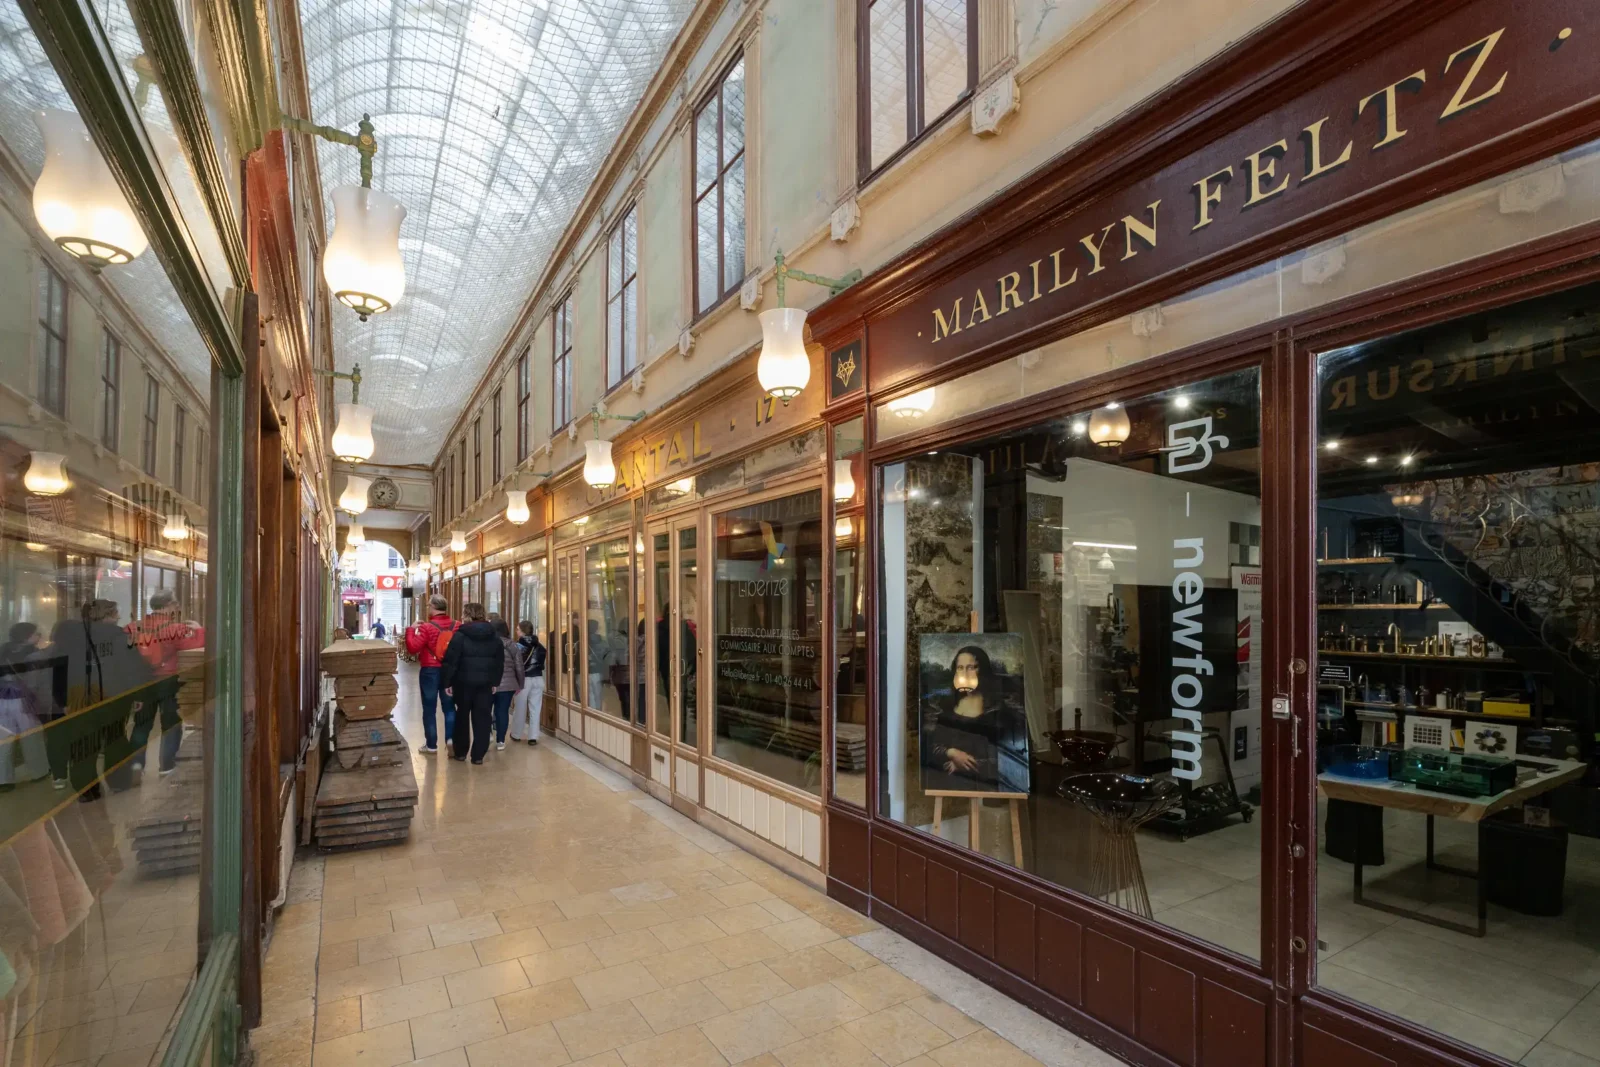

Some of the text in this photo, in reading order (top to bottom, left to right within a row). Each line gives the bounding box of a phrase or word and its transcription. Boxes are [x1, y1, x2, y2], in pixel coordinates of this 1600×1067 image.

[930, 26, 1508, 344] MARILYN FELTZ
[585, 393, 777, 506] ANTAL 17
[738, 576, 789, 597] Liberize
[720, 640, 815, 658] COMMISSAIRE AUX COMPTES
[1171, 537, 1214, 781] newform
[793, 677, 802, 689] 44
